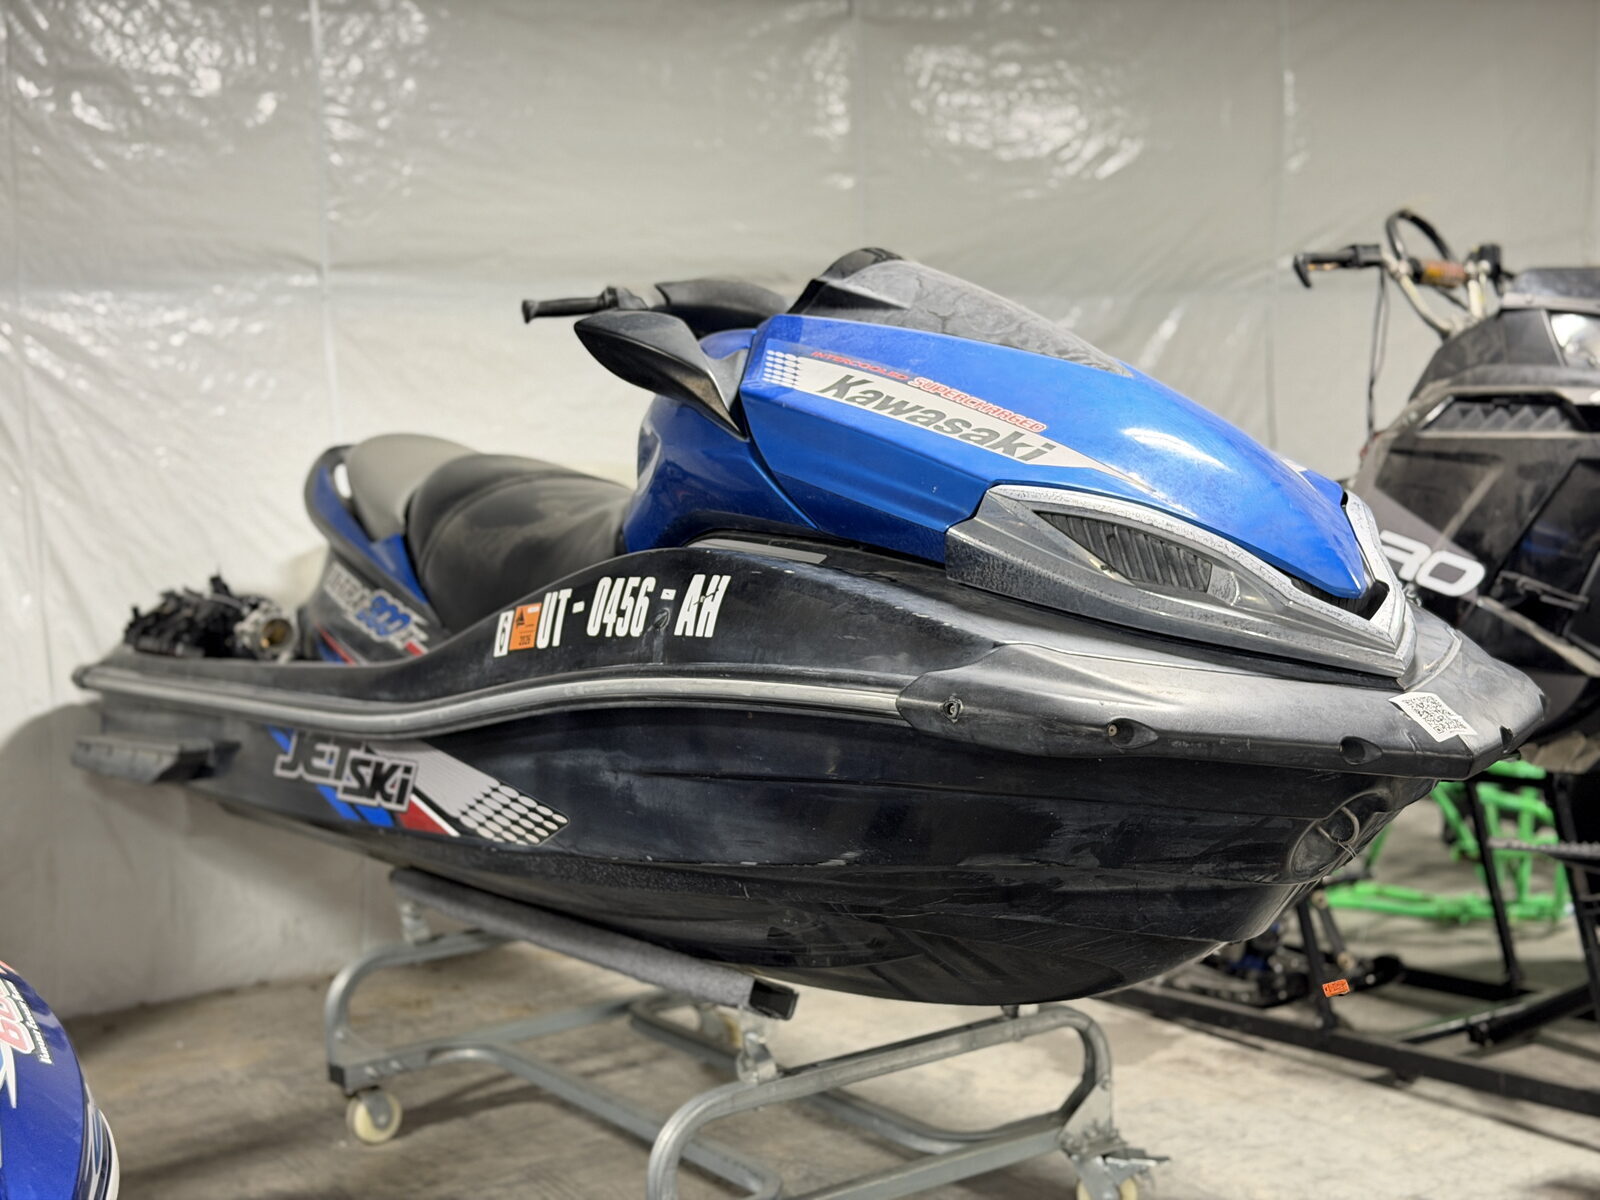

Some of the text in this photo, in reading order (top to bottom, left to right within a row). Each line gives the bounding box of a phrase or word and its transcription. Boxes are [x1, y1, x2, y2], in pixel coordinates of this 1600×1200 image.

[818, 374, 1056, 462] Kawasaki
[908, 376, 1048, 433] SUPERCHARGED
[536, 588, 572, 649] UT
[586, 576, 656, 638] 0456
[673, 574, 731, 638] AH
